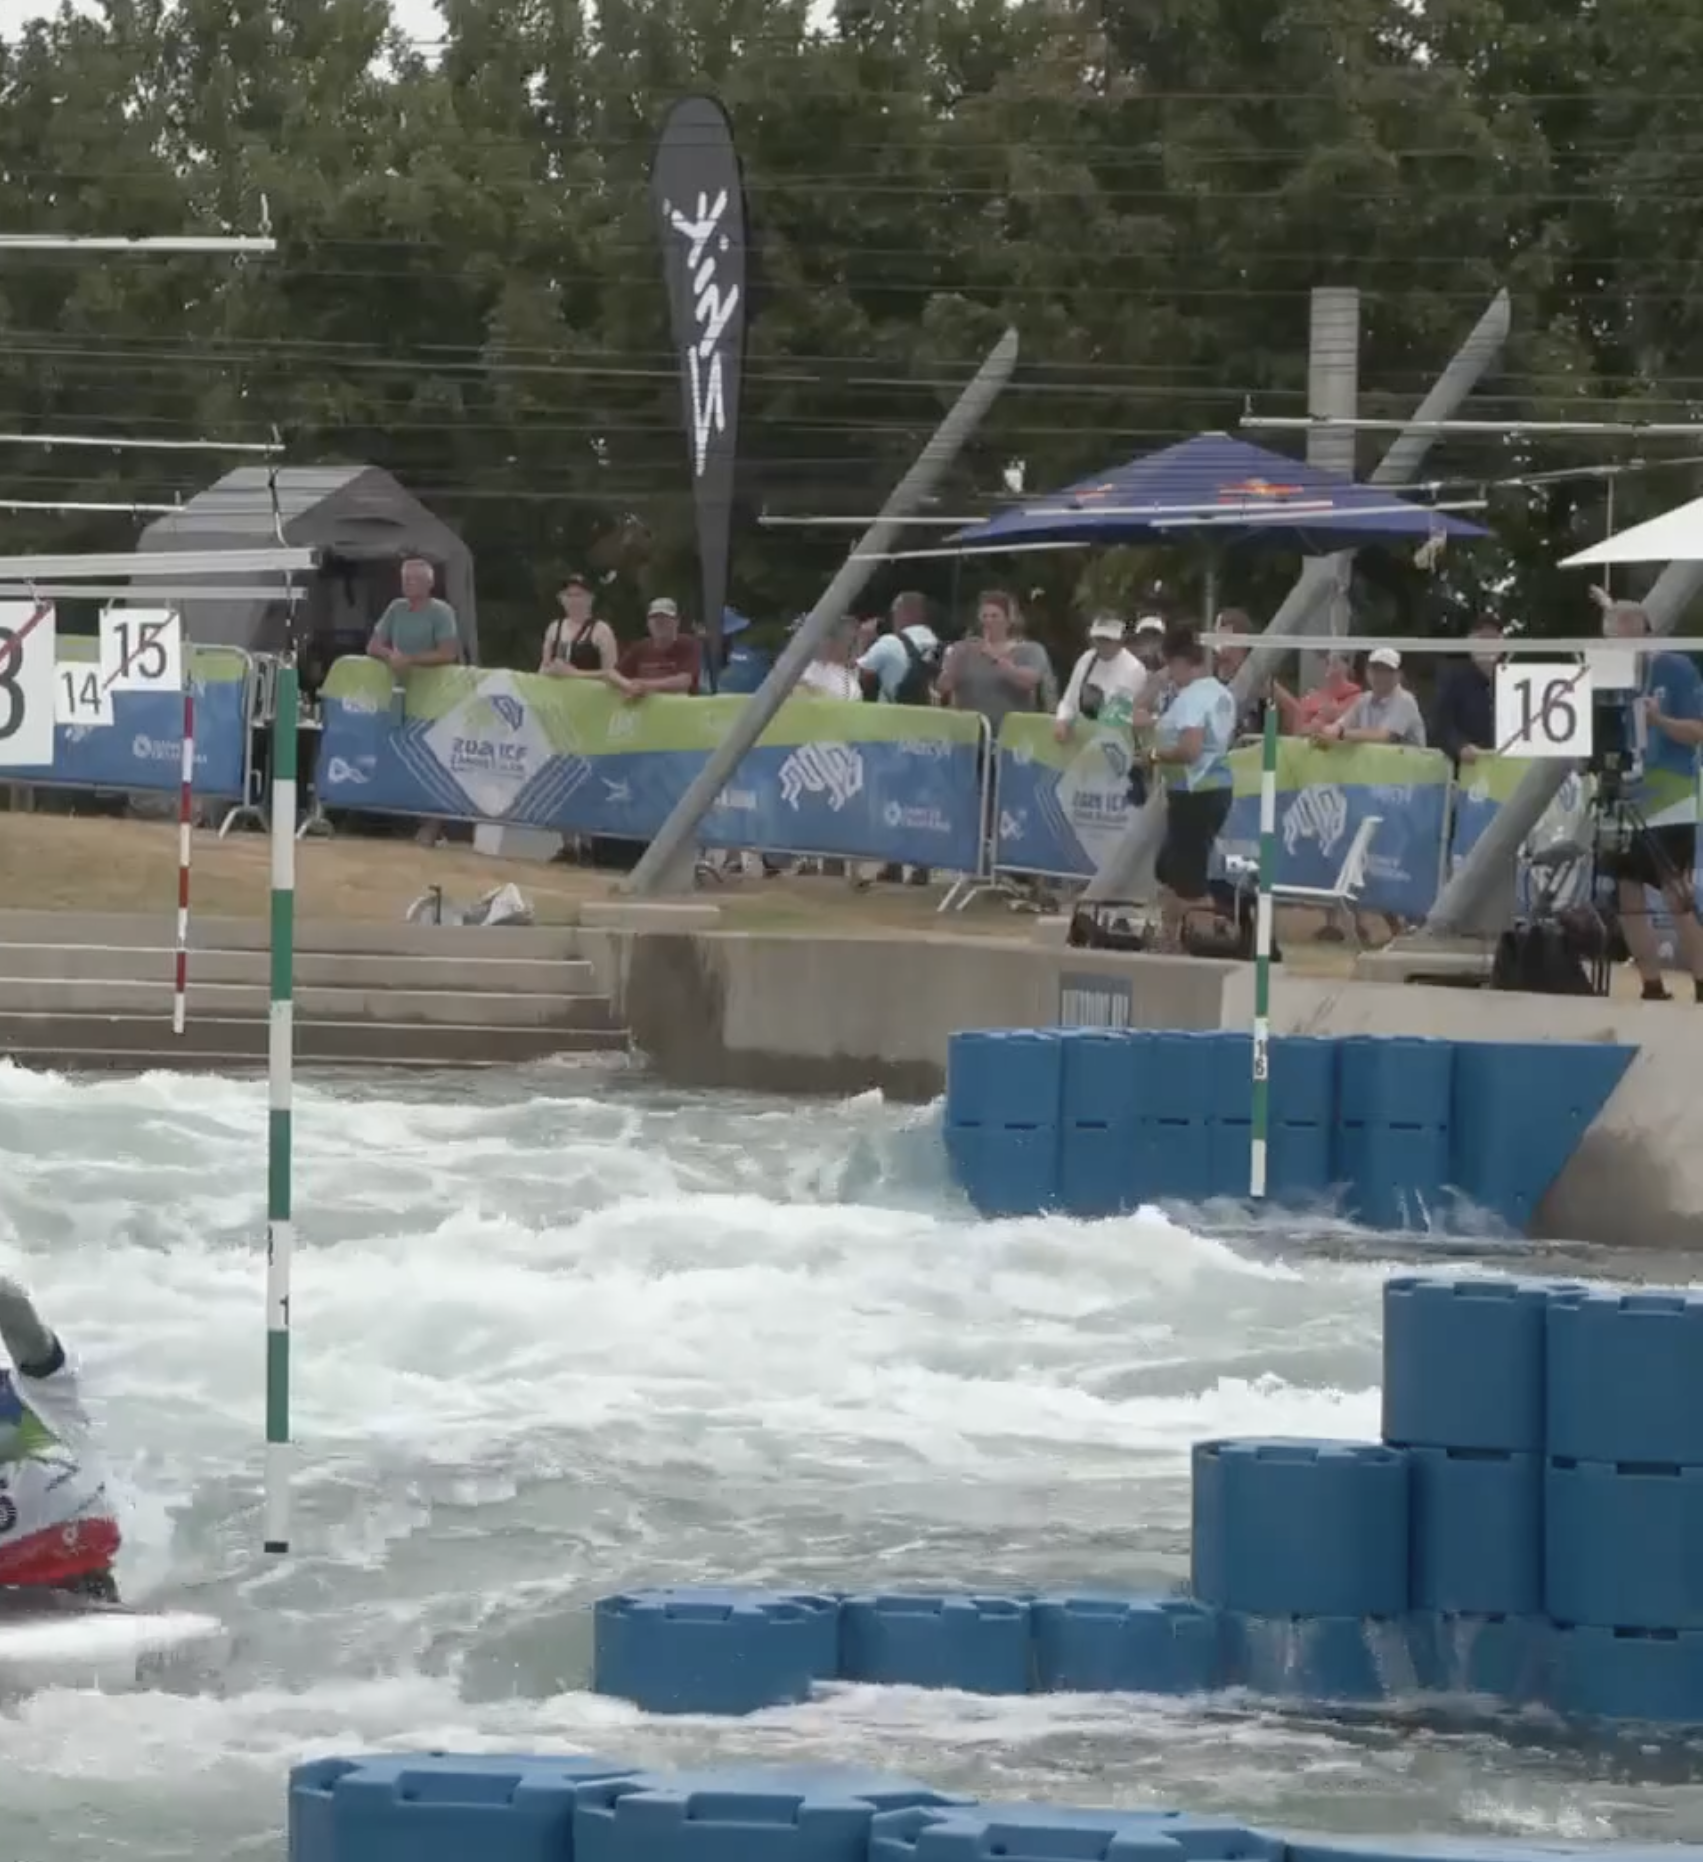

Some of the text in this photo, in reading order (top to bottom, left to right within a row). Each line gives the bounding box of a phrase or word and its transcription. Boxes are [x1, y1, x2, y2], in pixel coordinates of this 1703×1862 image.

[114, 622, 167, 679] 15
[61, 671, 101, 715] 14
[1514, 678, 1578, 743] 16
